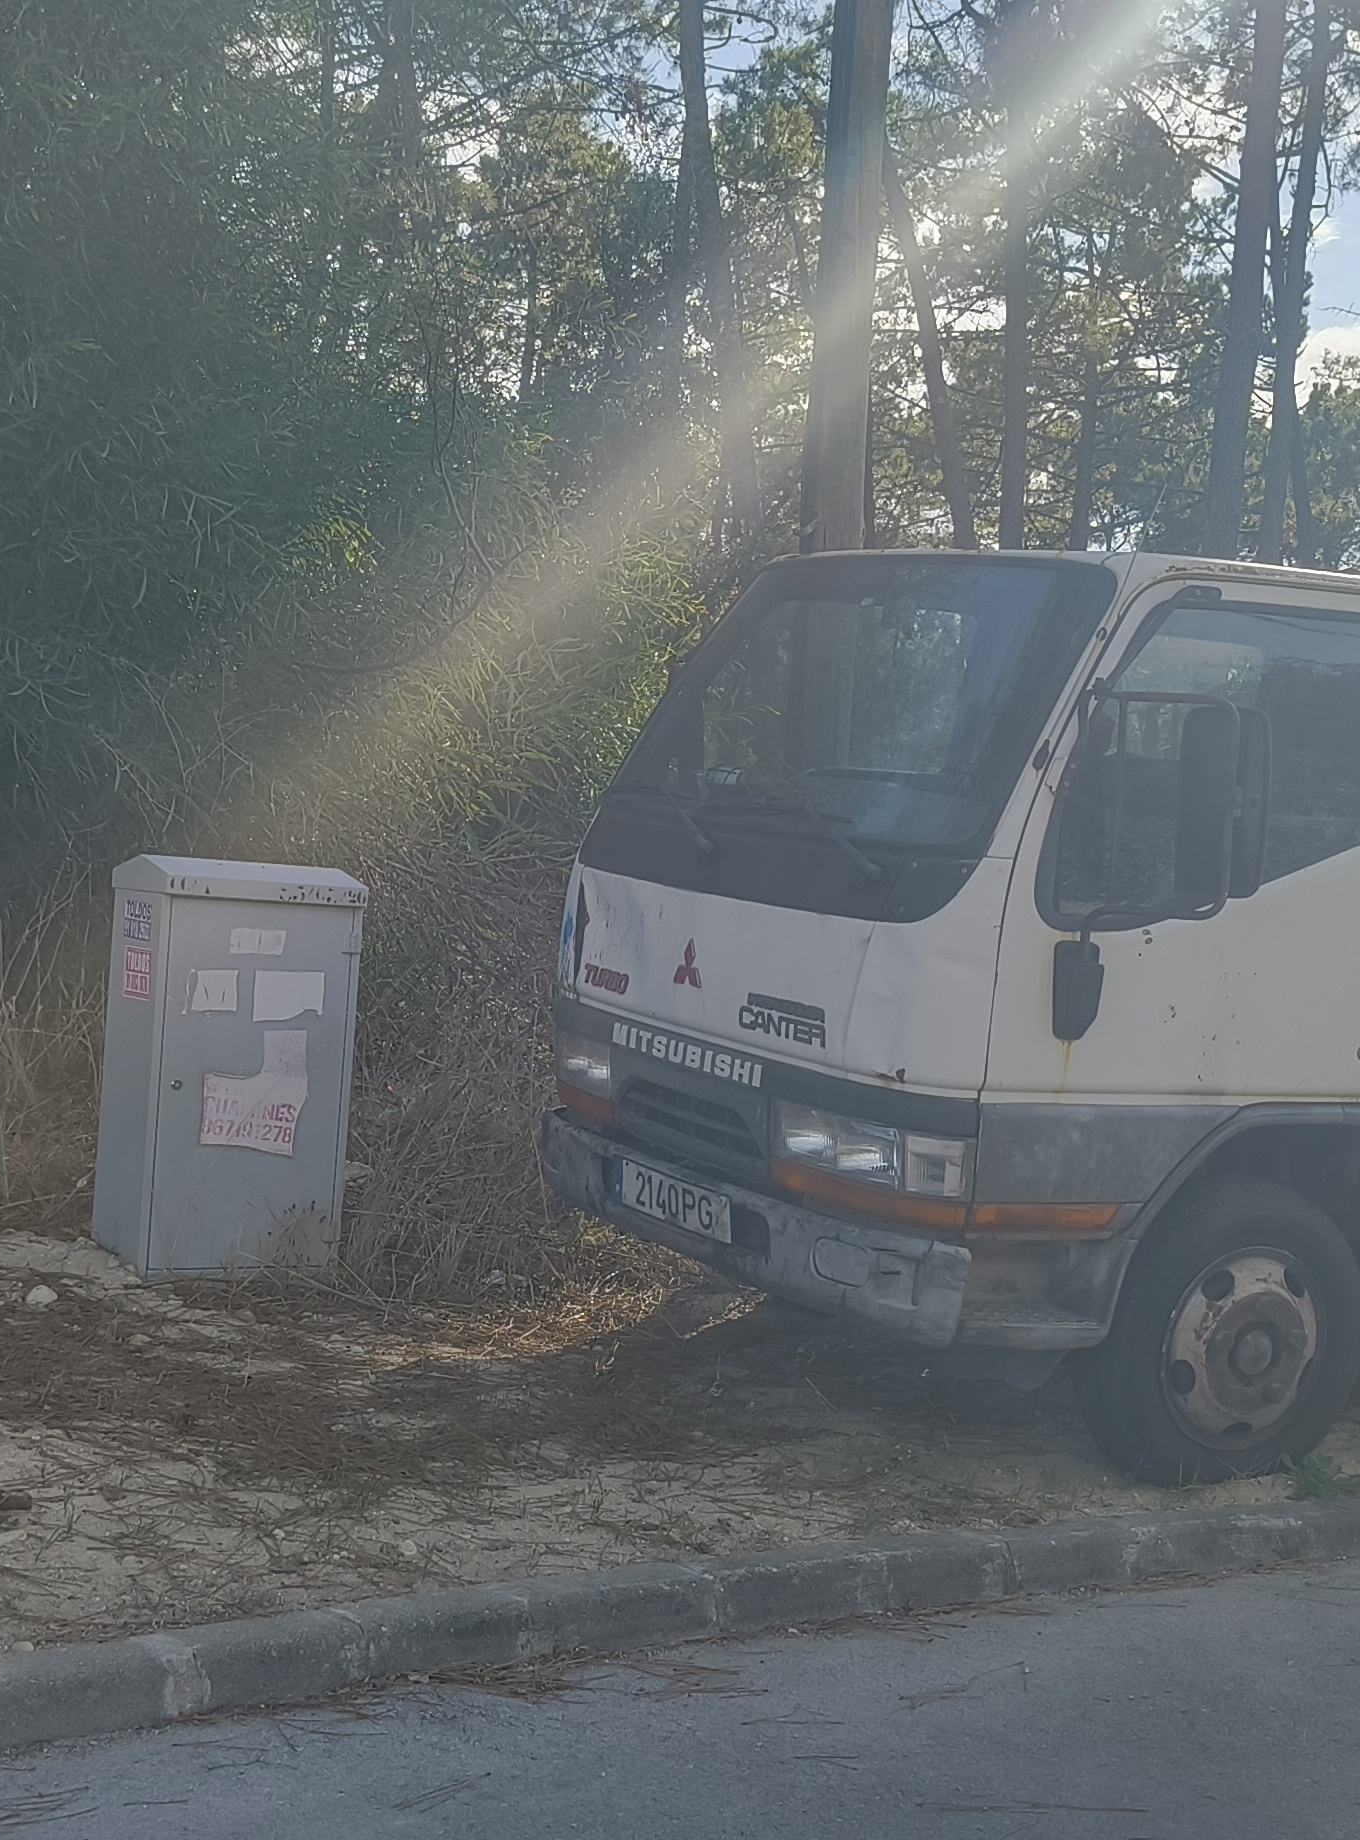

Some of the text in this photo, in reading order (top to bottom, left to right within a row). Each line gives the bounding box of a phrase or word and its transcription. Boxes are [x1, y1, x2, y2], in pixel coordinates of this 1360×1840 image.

[584, 962, 630, 995] TURBO
[739, 1005, 826, 1050] CANTER
[612, 1022, 763, 1088] MITSUBISHI
[635, 1170, 713, 1231] 2140PG
